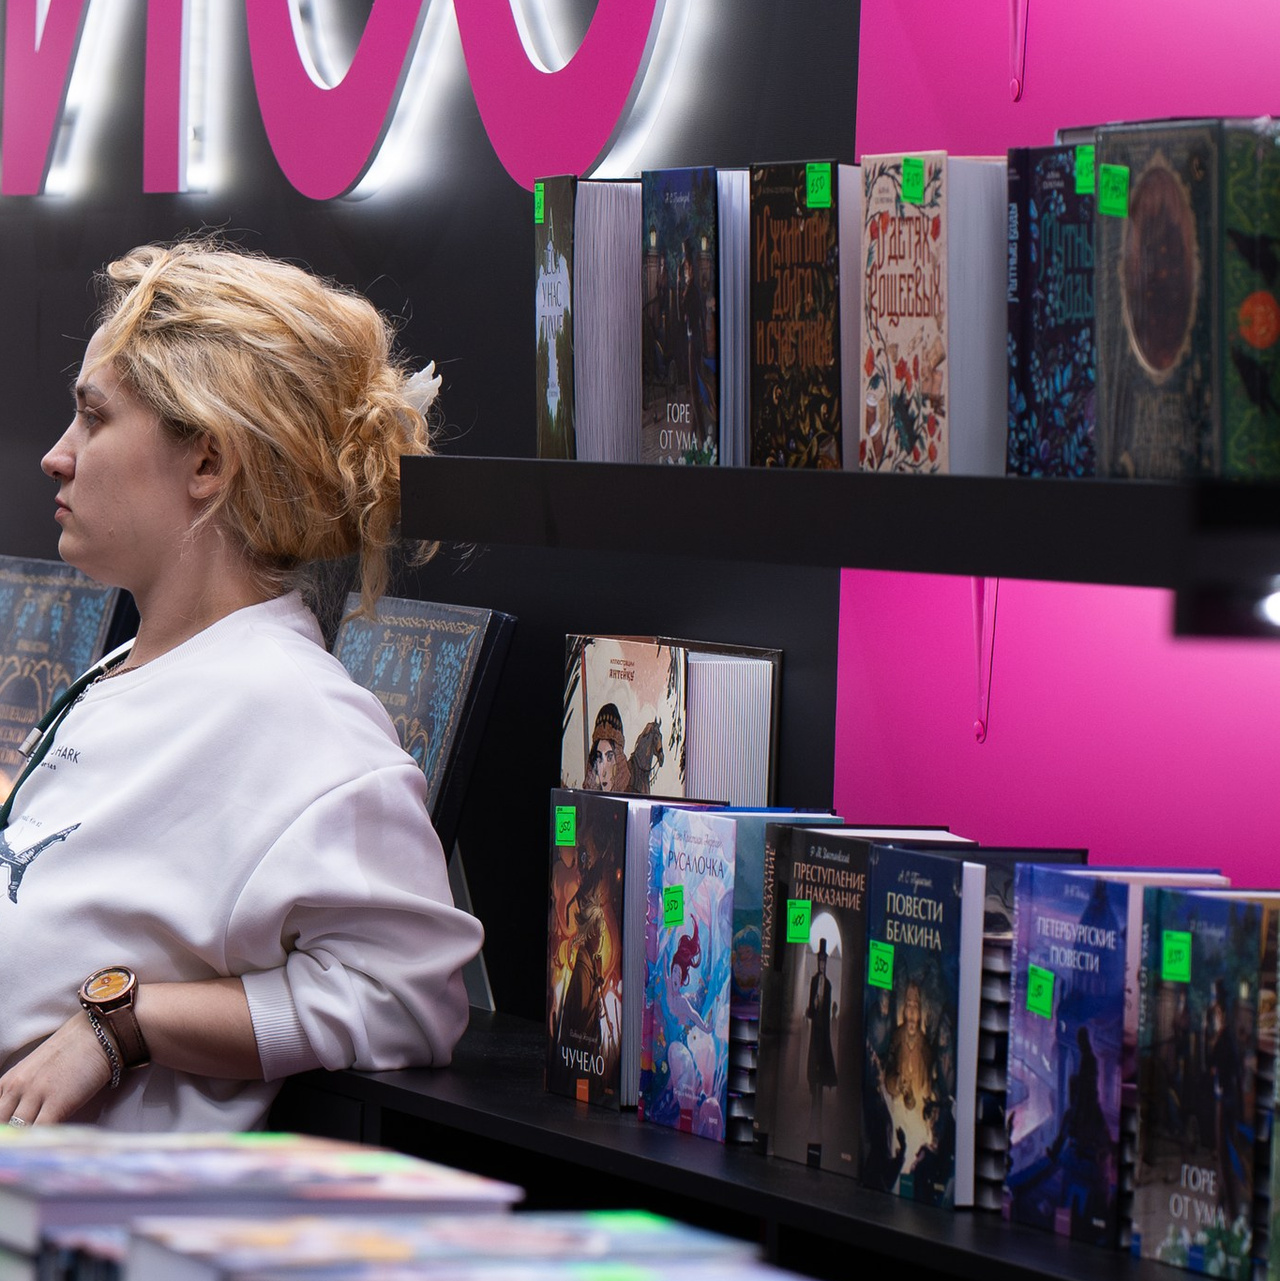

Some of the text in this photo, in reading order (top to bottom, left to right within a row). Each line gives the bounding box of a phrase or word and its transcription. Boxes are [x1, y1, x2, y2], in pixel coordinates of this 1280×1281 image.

[888, 216, 931, 268] ДЕТЯХ
[866, 262, 941, 328] КОЩЕЕВЫХ
[666, 403, 691, 424] ГОРЕ
[659, 429, 698, 451] ОТ УМА
[667, 850, 724, 879] РУСАЛОЧКА
[793, 861, 866, 892] ПРЕСТУПЛЕНИЕ
[795, 881, 862, 912] И НАКАЗАНИЕ
[886, 891, 943, 923] ПОВЕСТИ
[886, 919, 942, 952] БЕЛКИНА
[1036, 916, 1117, 950] ПЕТЕРБУРГСКИЕ
[1049, 945, 1100, 973] ПОВЕСТИ
[561, 1045, 605, 1076] ЧУЧЕЛО
[1181, 1163, 1217, 1195] ГОРЕ
[1170, 1193, 1227, 1230] ОТ УМА
